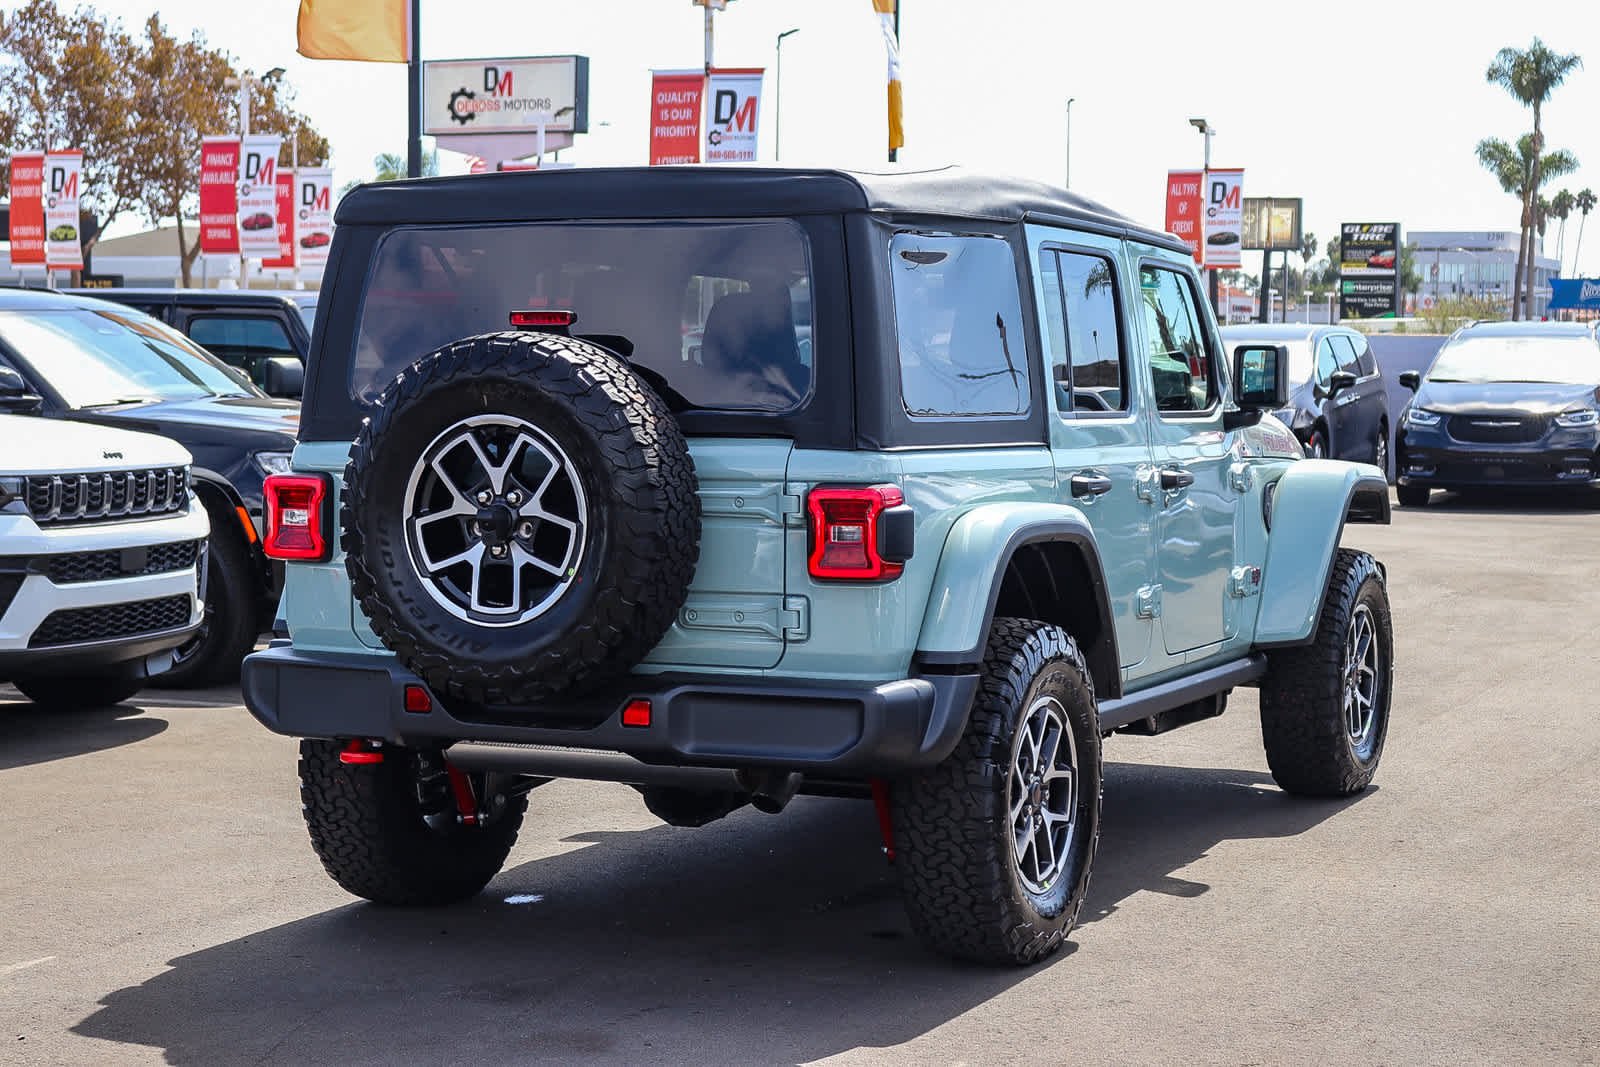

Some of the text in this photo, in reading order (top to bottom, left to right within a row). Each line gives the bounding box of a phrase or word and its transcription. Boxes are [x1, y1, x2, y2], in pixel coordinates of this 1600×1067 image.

[484, 67, 513, 97] DM
[503, 97, 552, 111] MOTORS
[656, 91, 698, 105] QUALITY
[661, 108, 692, 121] IS OUR
[714, 89, 757, 132] DM
[655, 124, 697, 138] PRIORITY
[206, 153, 234, 166] FINANCE
[246, 153, 275, 185] DM
[51, 167, 79, 199] DM
[202, 171, 236, 184] AVAILABLE
[302, 183, 330, 211] DM
[1171, 184, 1198, 196] ALL TYPE
[1211, 182, 1240, 209] DM
[1178, 202, 1188, 215] OF
[1171, 221, 1194, 233] CREDIT
